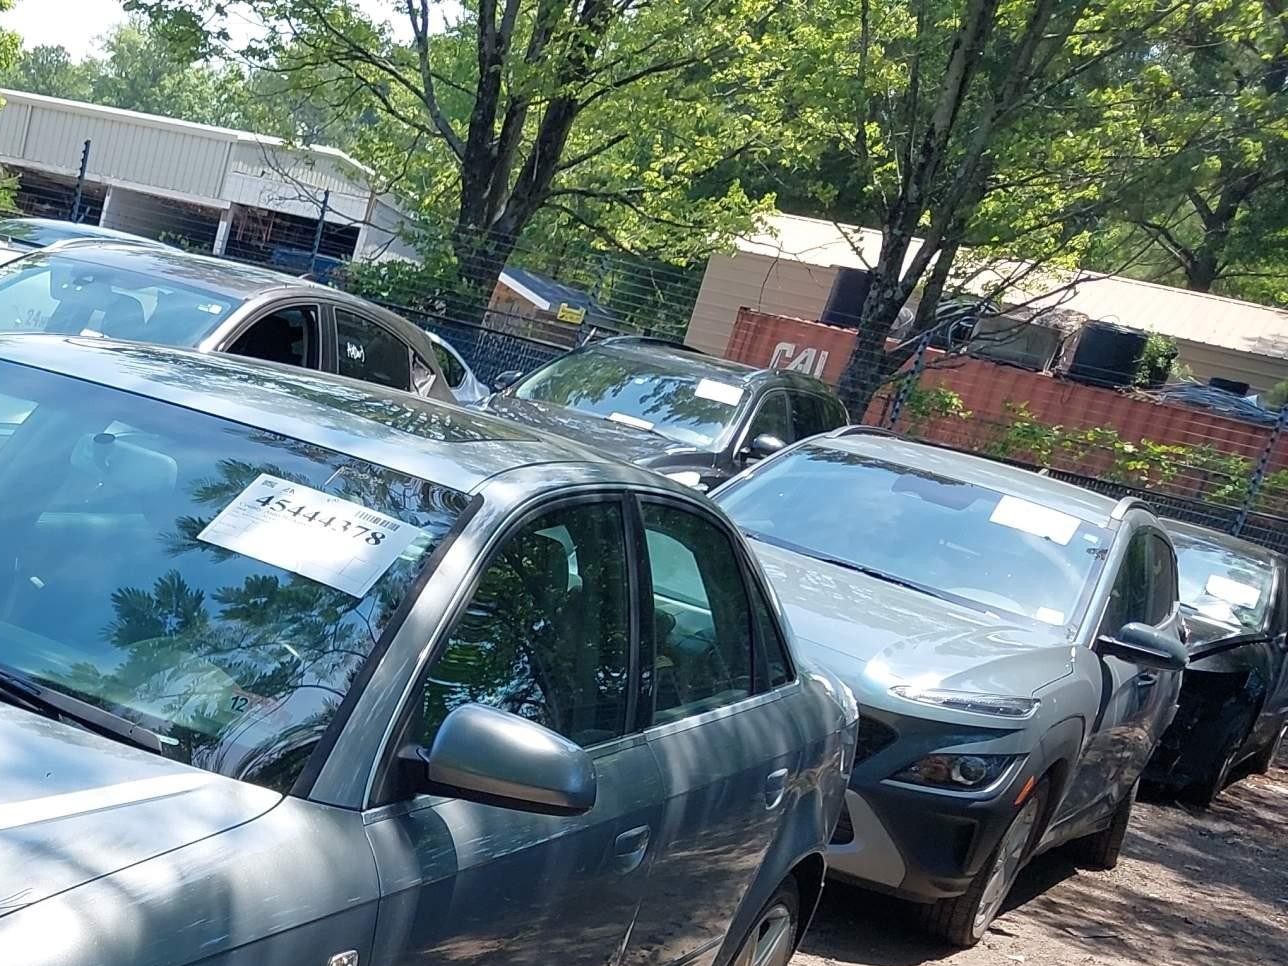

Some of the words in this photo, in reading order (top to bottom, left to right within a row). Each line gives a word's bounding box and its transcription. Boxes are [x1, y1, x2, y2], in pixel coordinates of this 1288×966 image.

[769, 342, 829, 379] CAI
[255, 494, 387, 546] 45444378
[231, 695, 249, 713] 12
